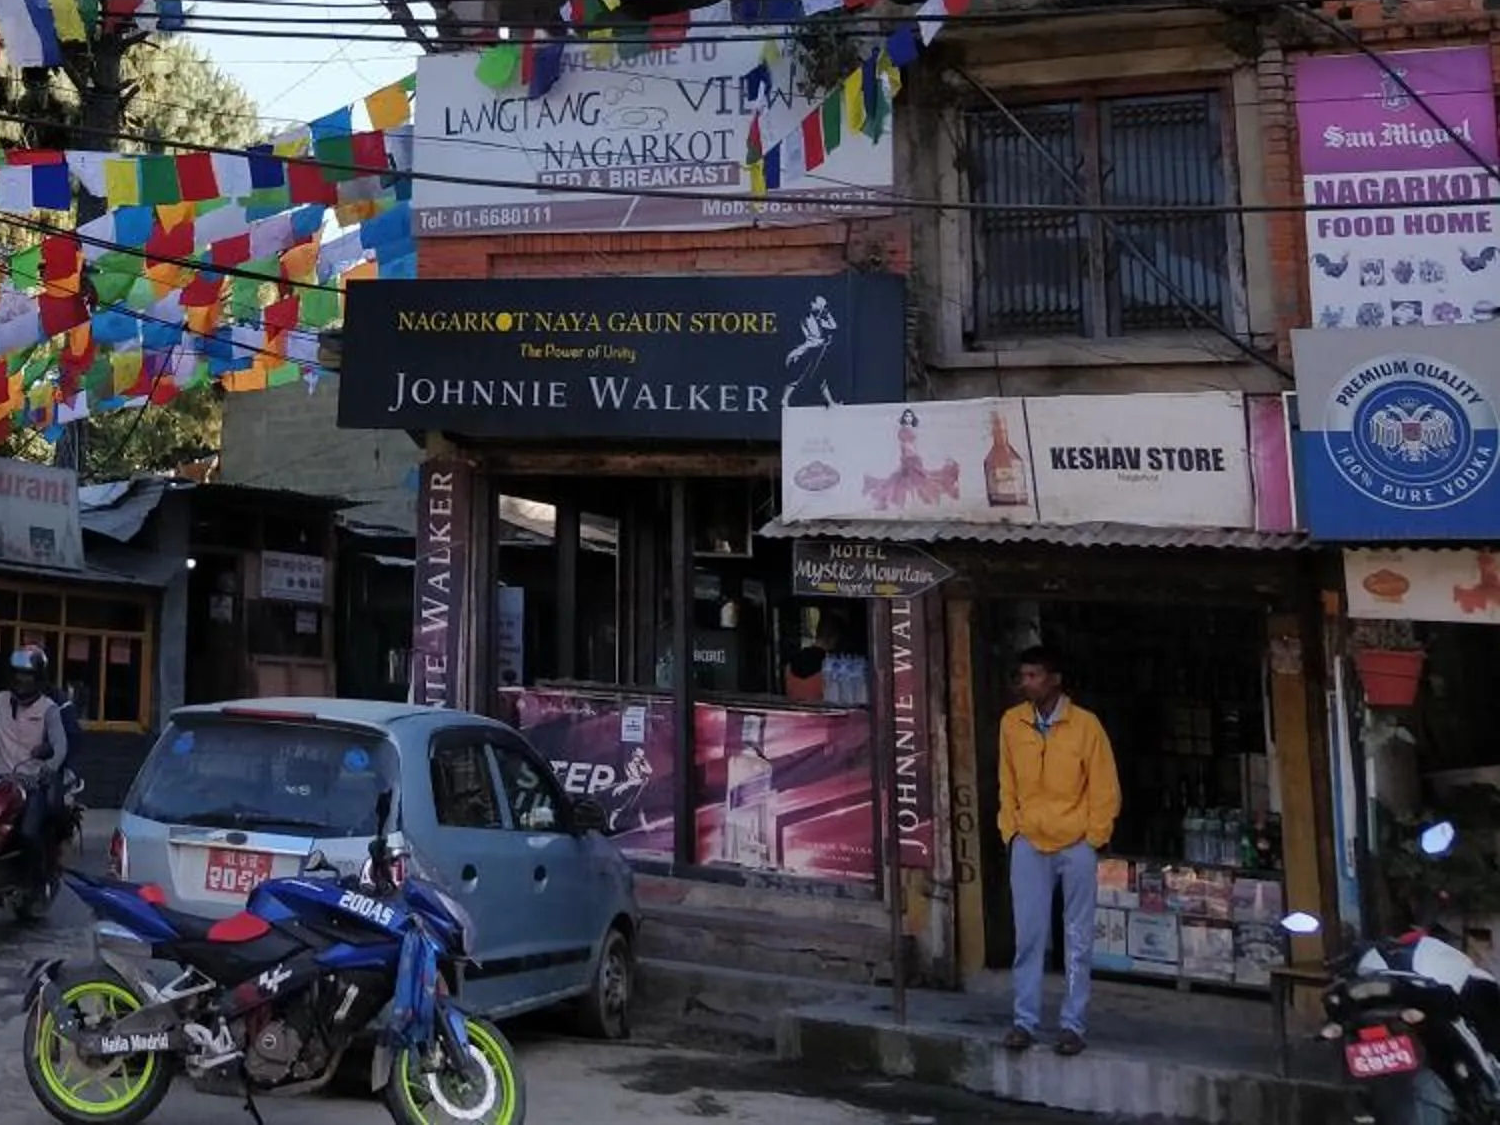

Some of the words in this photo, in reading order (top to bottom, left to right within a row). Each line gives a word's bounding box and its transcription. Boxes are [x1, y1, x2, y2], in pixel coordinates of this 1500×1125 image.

[444, 90, 600, 136] LANGTANG
[543, 129, 734, 171] NAGARKOT
[1322, 124, 1377, 149] San
[1378, 117, 1474, 150] Miguel
[608, 164, 733, 188] BREAKFAST
[1313, 172, 1491, 205] NAGARKOT
[419, 212, 448, 229] Tel:
[1316, 215, 1395, 239] FOOD
[1402, 210, 1493, 236] HOME
[534, 312, 601, 332] NAYA
[607, 312, 683, 332] GAUN
[689, 312, 778, 333] STORE
[520, 343, 542, 359] The
[544, 345, 585, 360] Power
[587, 343, 601, 360] of
[603, 343, 637, 363] Unity
[387, 371, 568, 413] JOHNNIE
[588, 374, 771, 413] WALKER
[1335, 360, 1409, 408] PREMIUM
[1413, 362, 1485, 405] QUALITY
[1050, 447, 1141, 472] KESHAV
[1146, 447, 1226, 472] STORE
[1380, 482, 1437, 502] PURE
[1442, 445, 1493, 497] VODKA
[421, 471, 453, 634] WALKER
[829, 544, 887, 560] HOTEL
[794, 559, 856, 586] Mystic
[894, 694, 932, 855] JOHNNIE
[339, 889, 395, 926] 200AS
